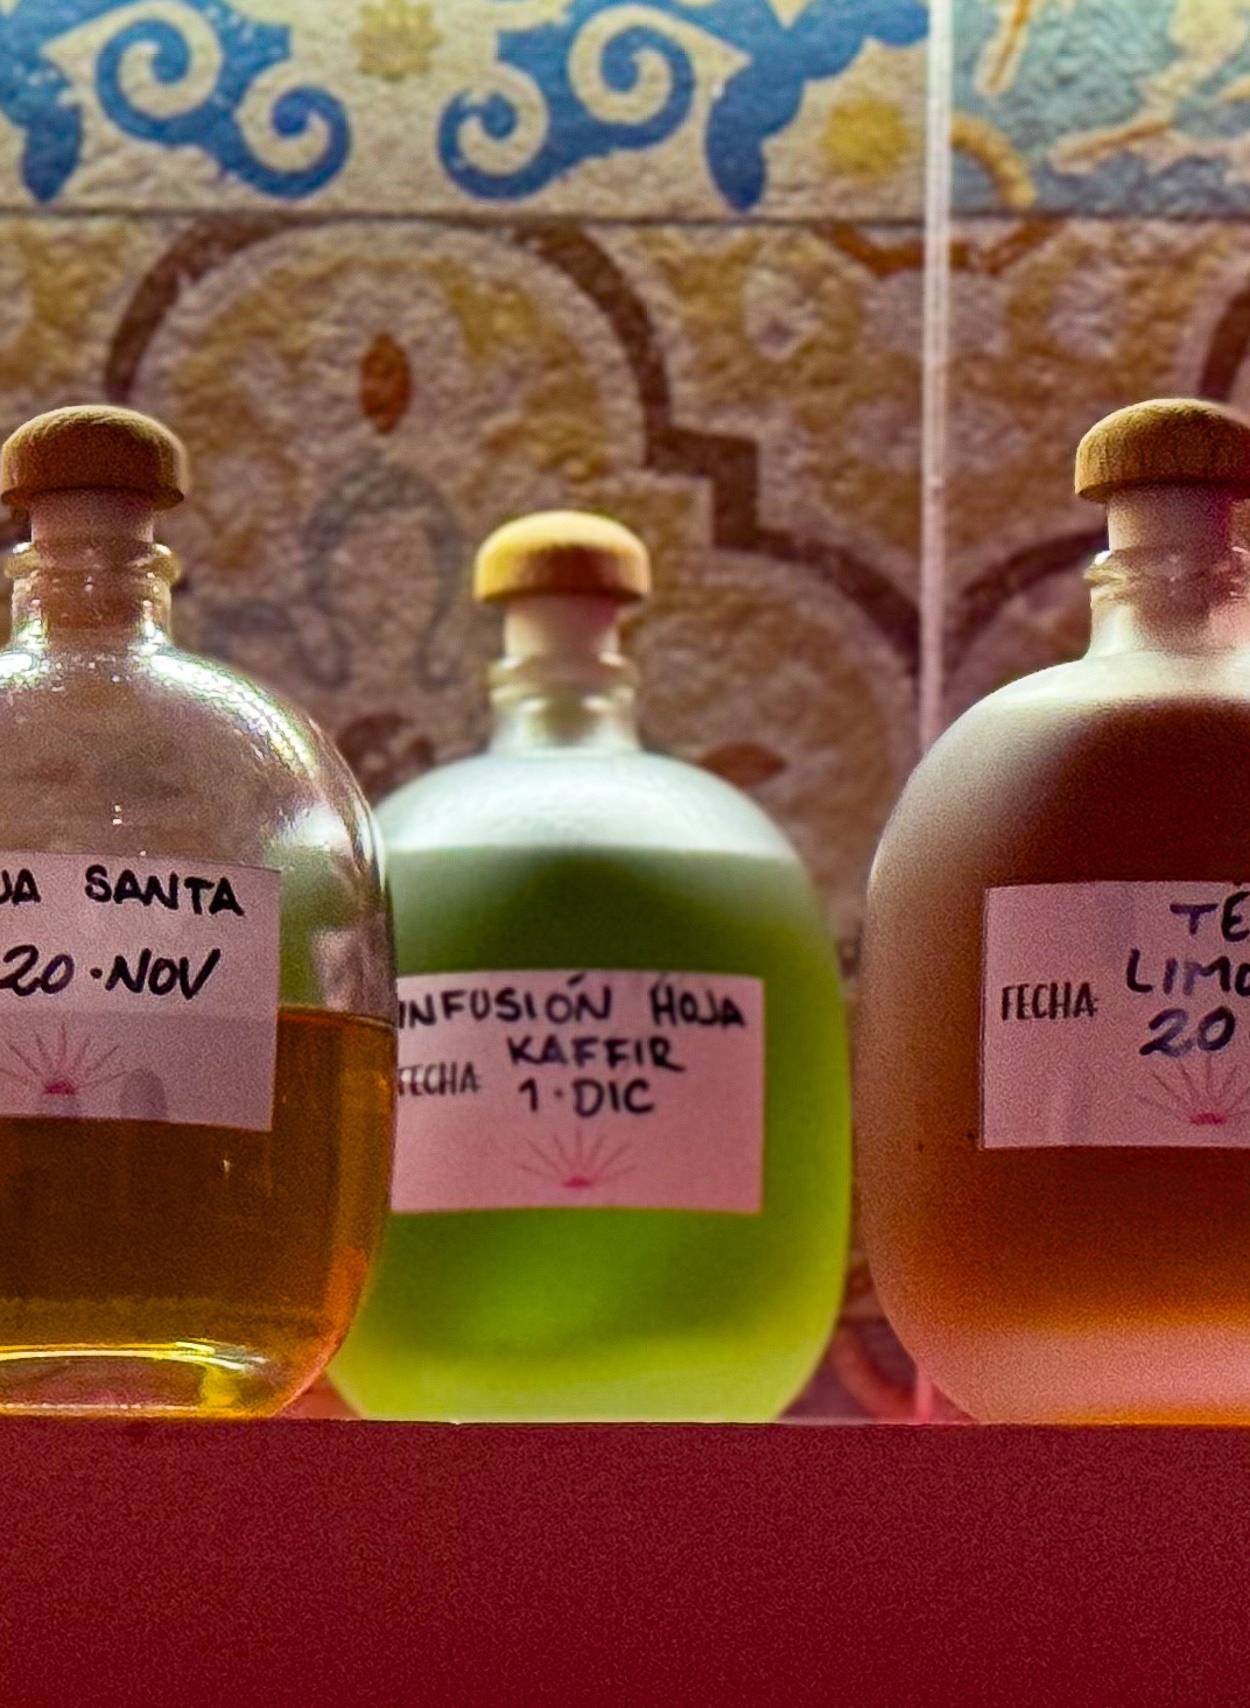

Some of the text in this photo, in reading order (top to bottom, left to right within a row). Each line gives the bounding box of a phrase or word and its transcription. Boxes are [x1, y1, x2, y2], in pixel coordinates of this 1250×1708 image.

[84, 864, 245, 917] SANTA
[398, 972, 747, 1030] INFUSIÓN HOJA
[507, 1034, 685, 1073] KAFFIR
